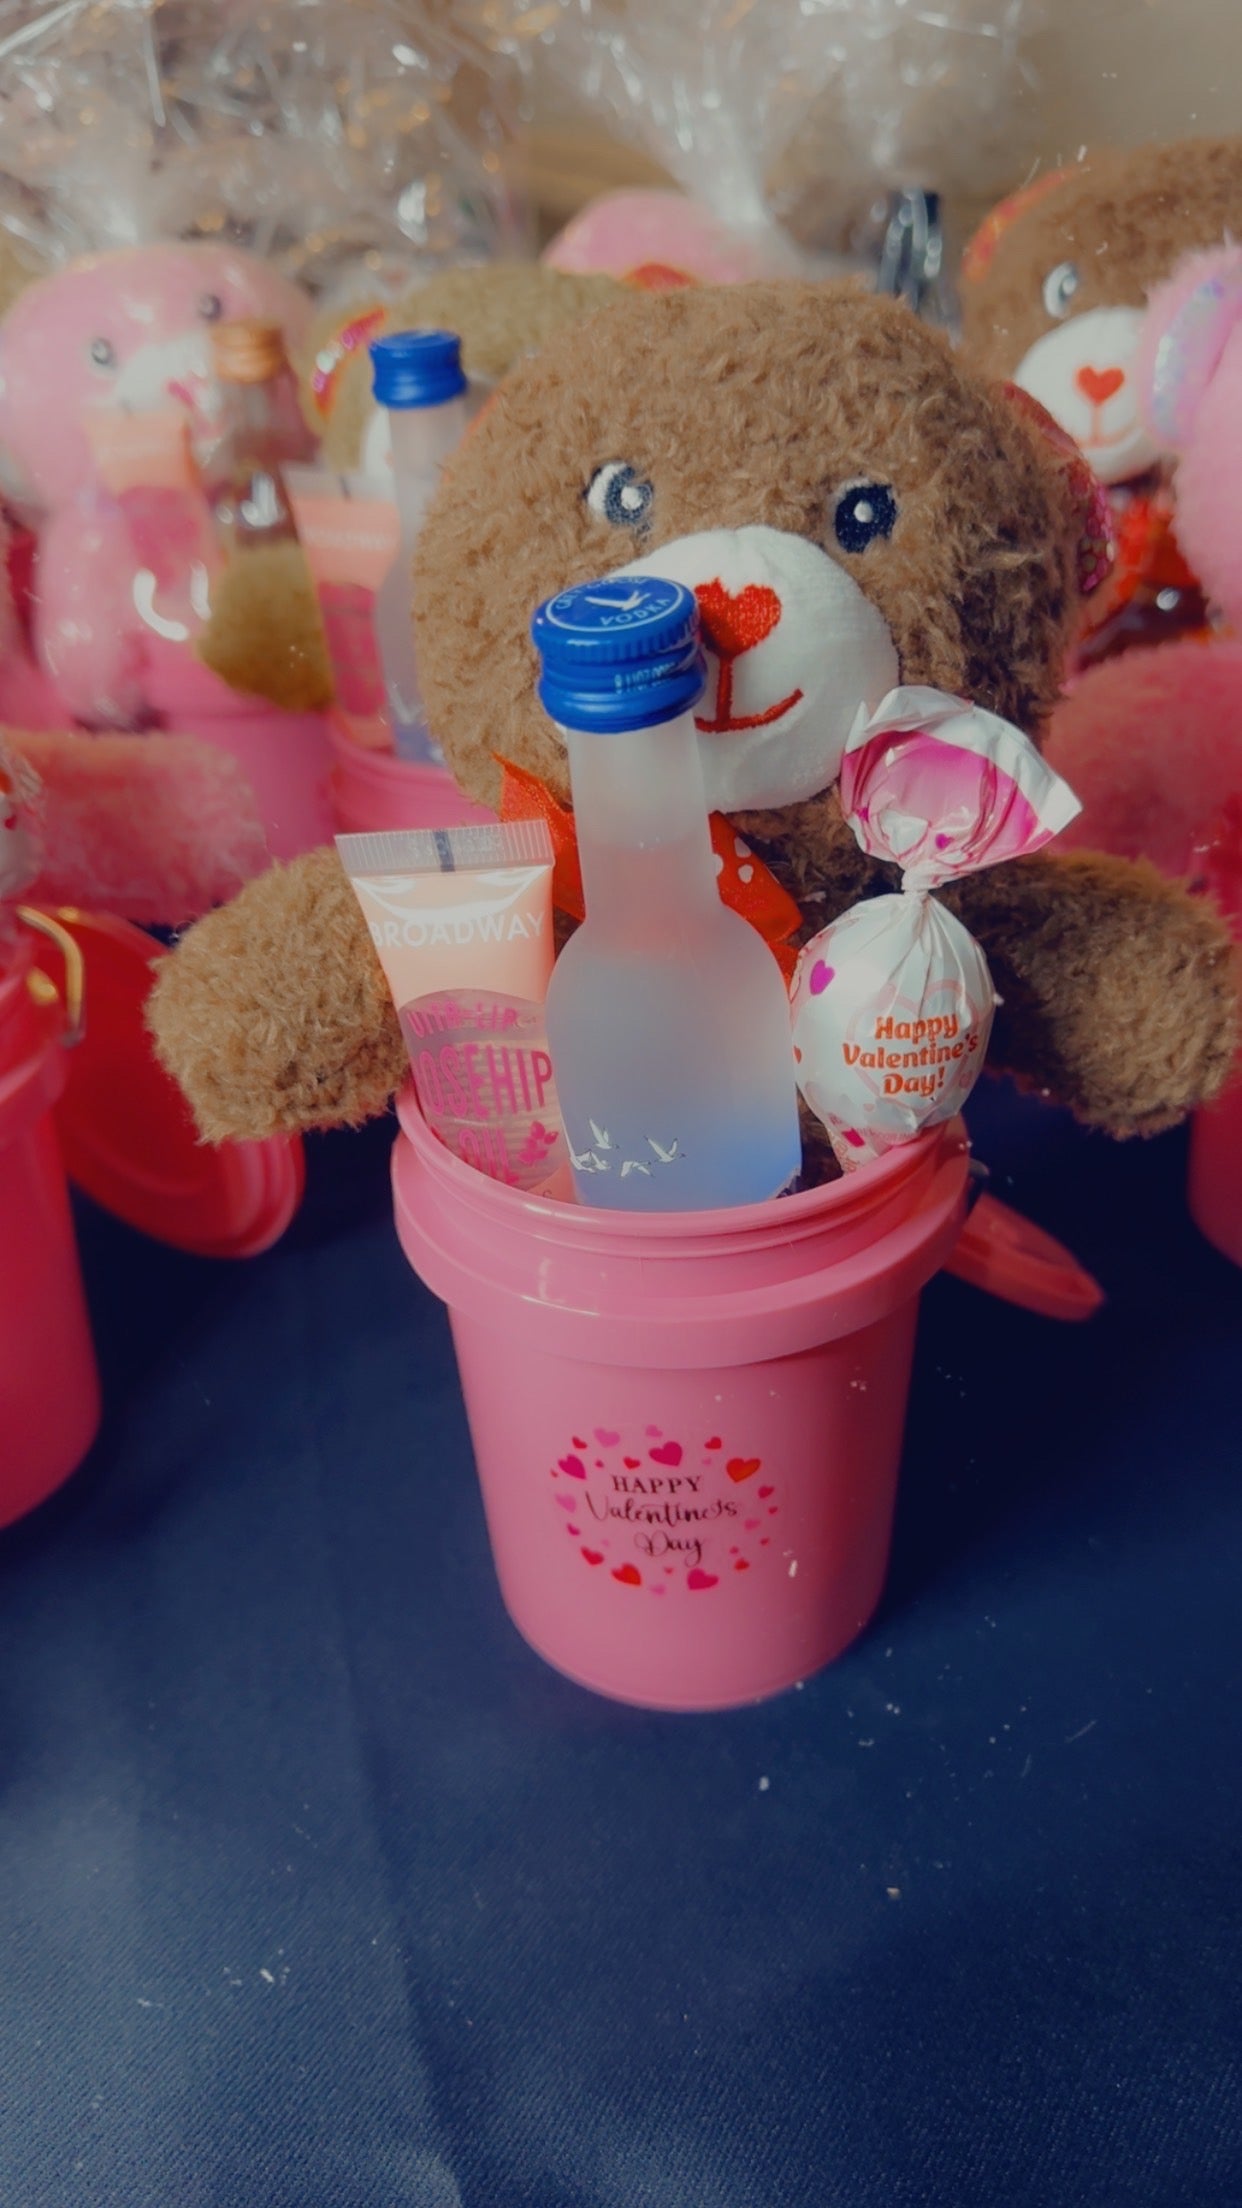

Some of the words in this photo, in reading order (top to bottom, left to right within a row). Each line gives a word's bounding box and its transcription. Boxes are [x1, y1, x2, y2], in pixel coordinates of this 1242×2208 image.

[600, 598, 670, 626] VODKA
[369, 911, 546, 948] BROADWAY
[874, 1013, 959, 1044] Happy
[842, 1033, 979, 1069] Valentine's
[412, 1042, 553, 1120] OSEHIP
[883, 1066, 946, 1097] Day!
[611, 1475, 702, 1494] HAPPY
[585, 1491, 739, 1528] Valentine's
[634, 1530, 705, 1567] Day
